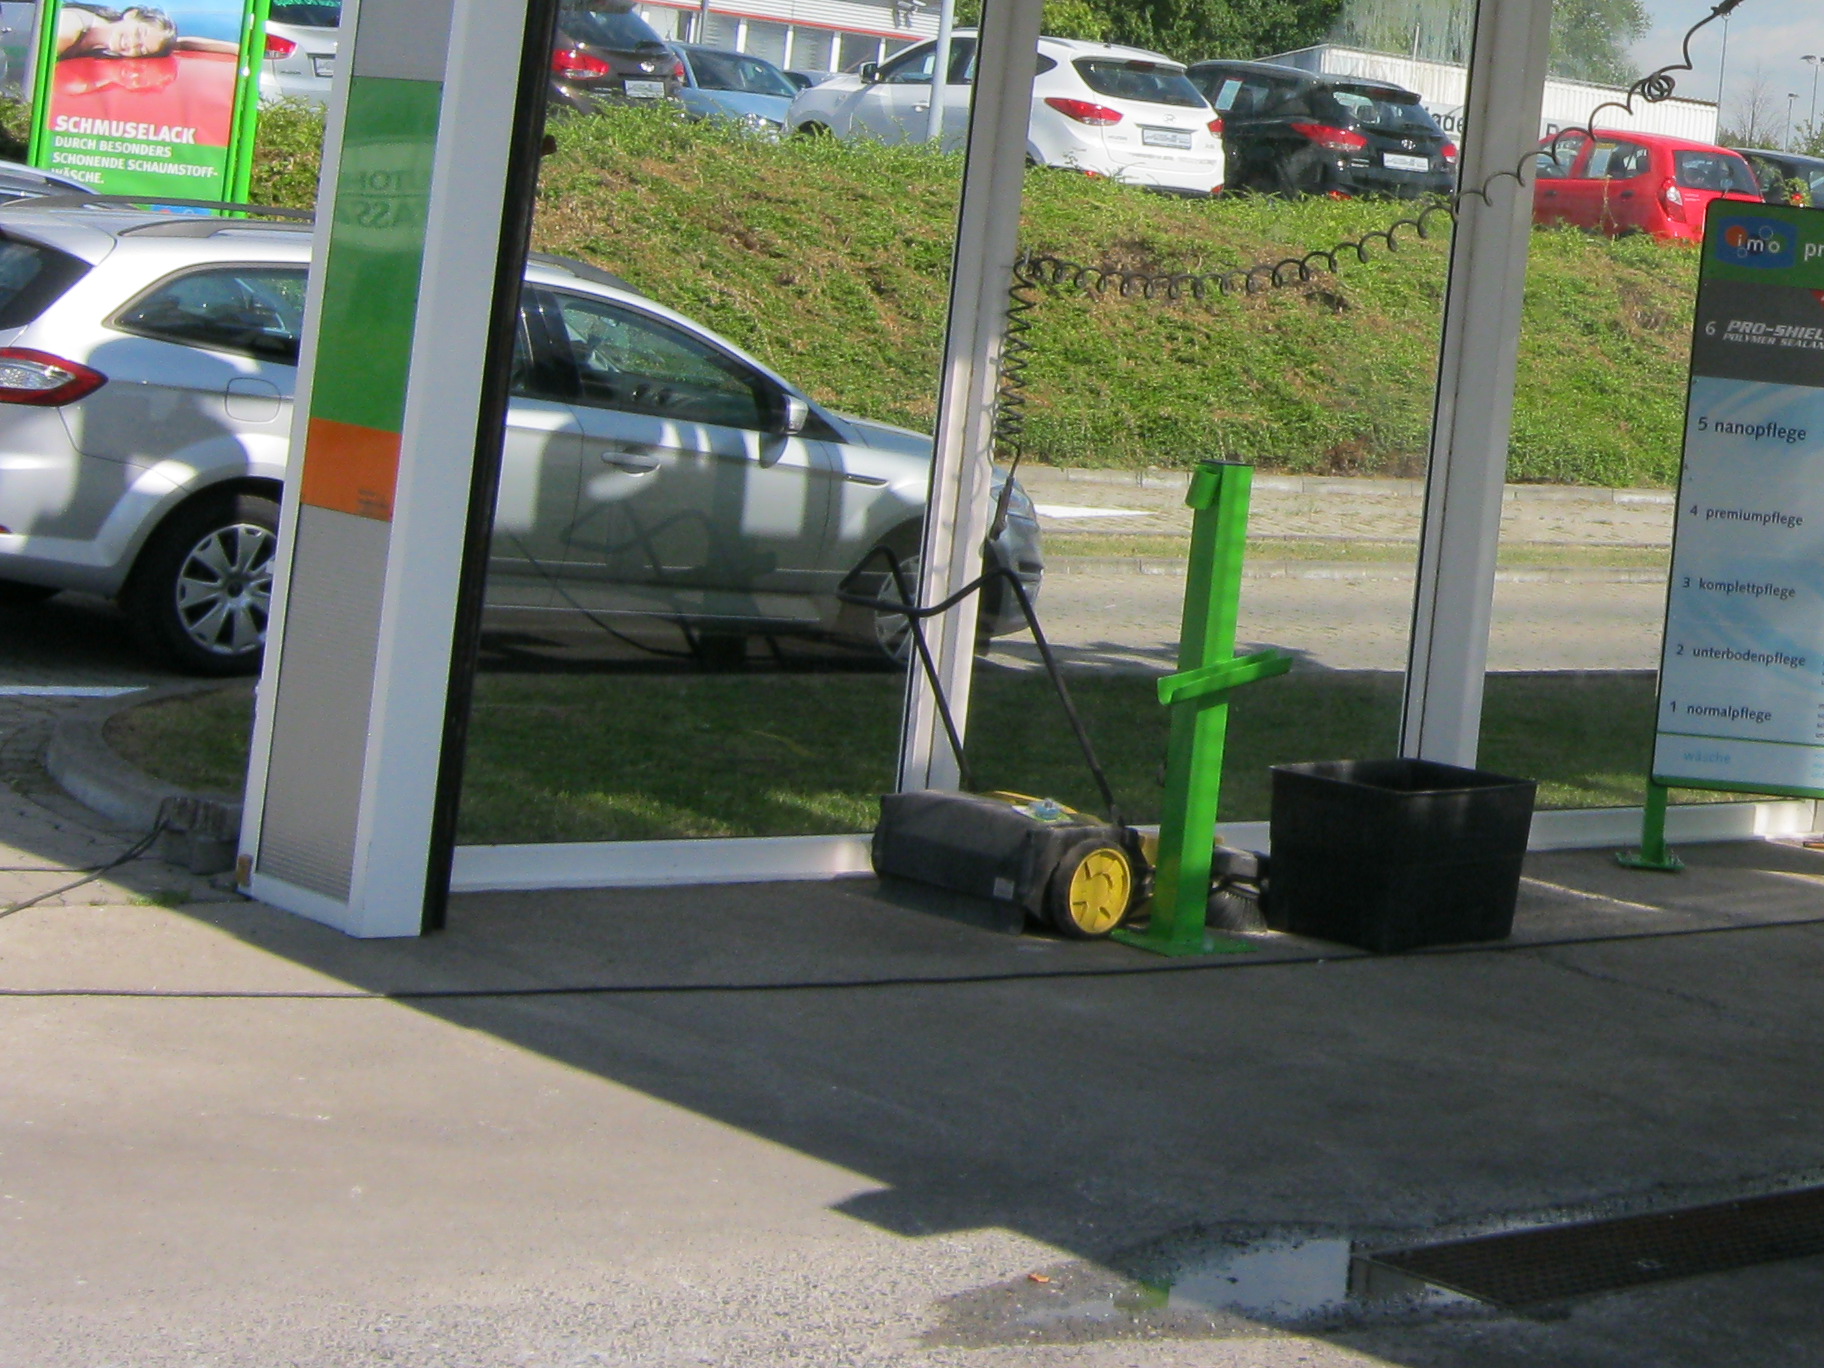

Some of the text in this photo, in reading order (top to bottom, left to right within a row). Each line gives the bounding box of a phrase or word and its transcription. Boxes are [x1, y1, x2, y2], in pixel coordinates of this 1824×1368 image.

[54, 114, 197, 144] SCHMUSELACK
[54, 135, 172, 158] DURCH BESONDERS
[52, 151, 219, 179] SCHONENDE SCHAUMSTOFF-
[1737, 233, 1781, 253] imo
[1705, 320, 1716, 336] 6
[1722, 332, 1776, 346] POLYMER
[1697, 416, 1807, 444] 5 nanopflege
[1690, 505, 1803, 528] 4 premiumpflege
[1682, 577, 1796, 600] 3 komplettpflege
[1676, 644, 1806, 669] 2 unterbodenpflege
[1670, 701, 1772, 724] 1 normalpflege
[1683, 750, 1731, 764] wäsche
